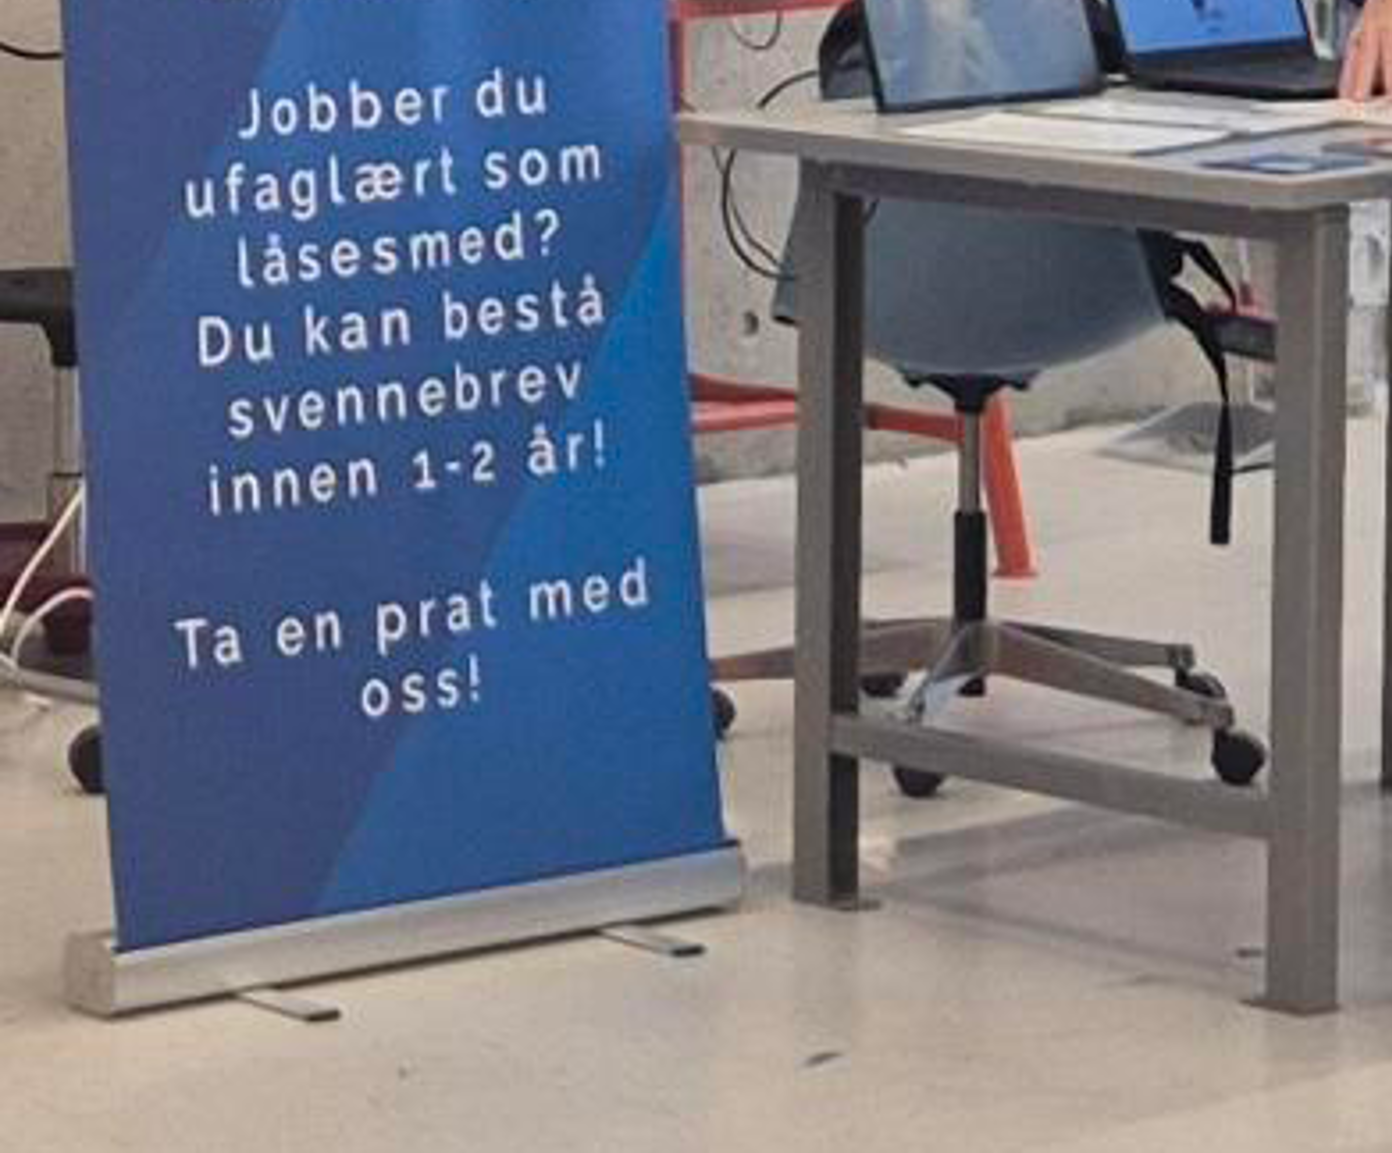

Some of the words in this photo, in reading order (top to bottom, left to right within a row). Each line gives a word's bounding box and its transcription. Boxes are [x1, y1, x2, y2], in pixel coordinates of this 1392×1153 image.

[238, 80, 448, 139] Jobber
[475, 67, 546, 118] du
[185, 148, 456, 222] ufaglært
[485, 144, 601, 190] som
[238, 209, 559, 288] låsesmed?
[198, 316, 273, 367] Du
[304, 305, 410, 354] kan
[442, 274, 604, 340] bestå
[228, 363, 580, 439] svennebrev
[209, 458, 377, 516] innen
[412, 441, 495, 490] 1-2
[527, 420, 603, 476] år!
[174, 618, 242, 668] Ta
[276, 611, 341, 656] en
[376, 581, 496, 656] prat
[529, 557, 648, 620] med
[361, 655, 480, 718] oss!
